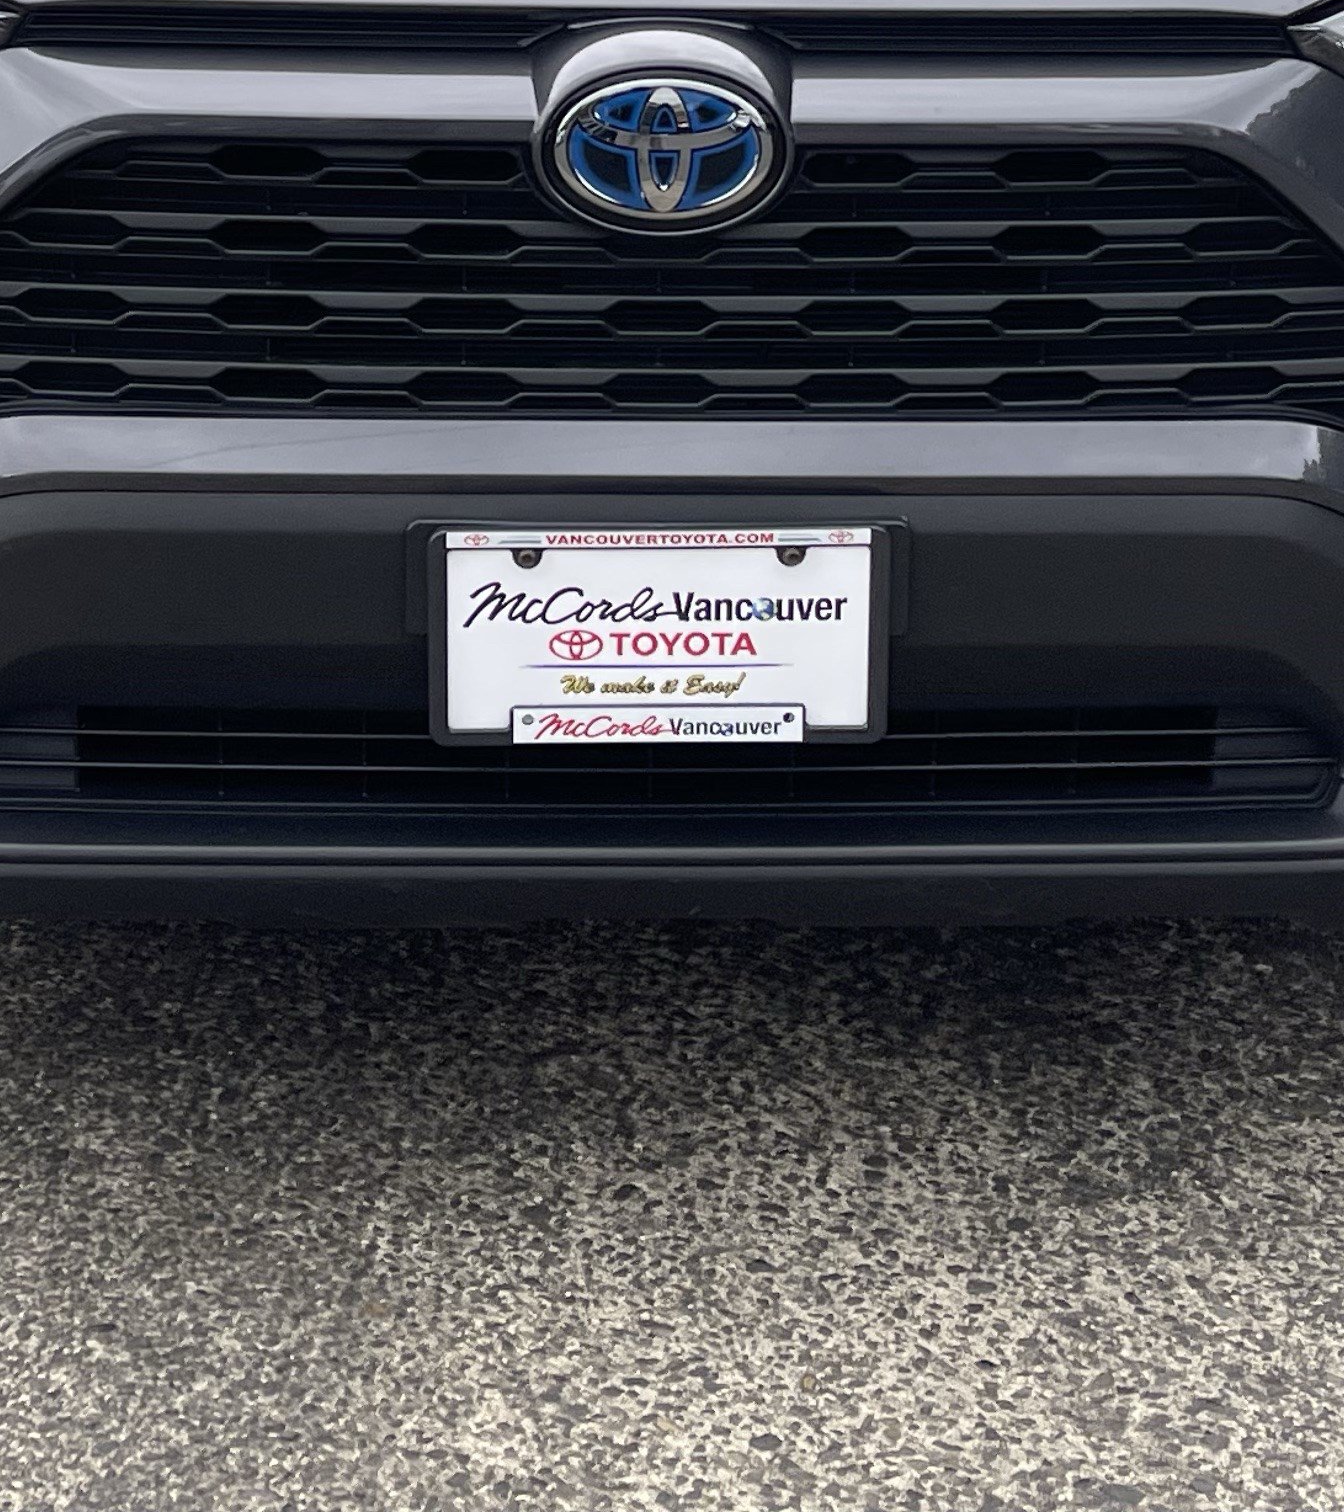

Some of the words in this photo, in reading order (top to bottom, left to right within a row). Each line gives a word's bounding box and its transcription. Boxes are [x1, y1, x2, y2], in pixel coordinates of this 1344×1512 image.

[545, 532, 775, 546] VANCOUVERTOYOTA.COM
[671, 591, 848, 622] Vancouver
[609, 632, 758, 656] TOYOTA
[560, 674, 595, 695] We
[600, 675, 655, 695] make
[683, 671, 747, 698] Easy!
[668, 717, 783, 738] Vancouver
